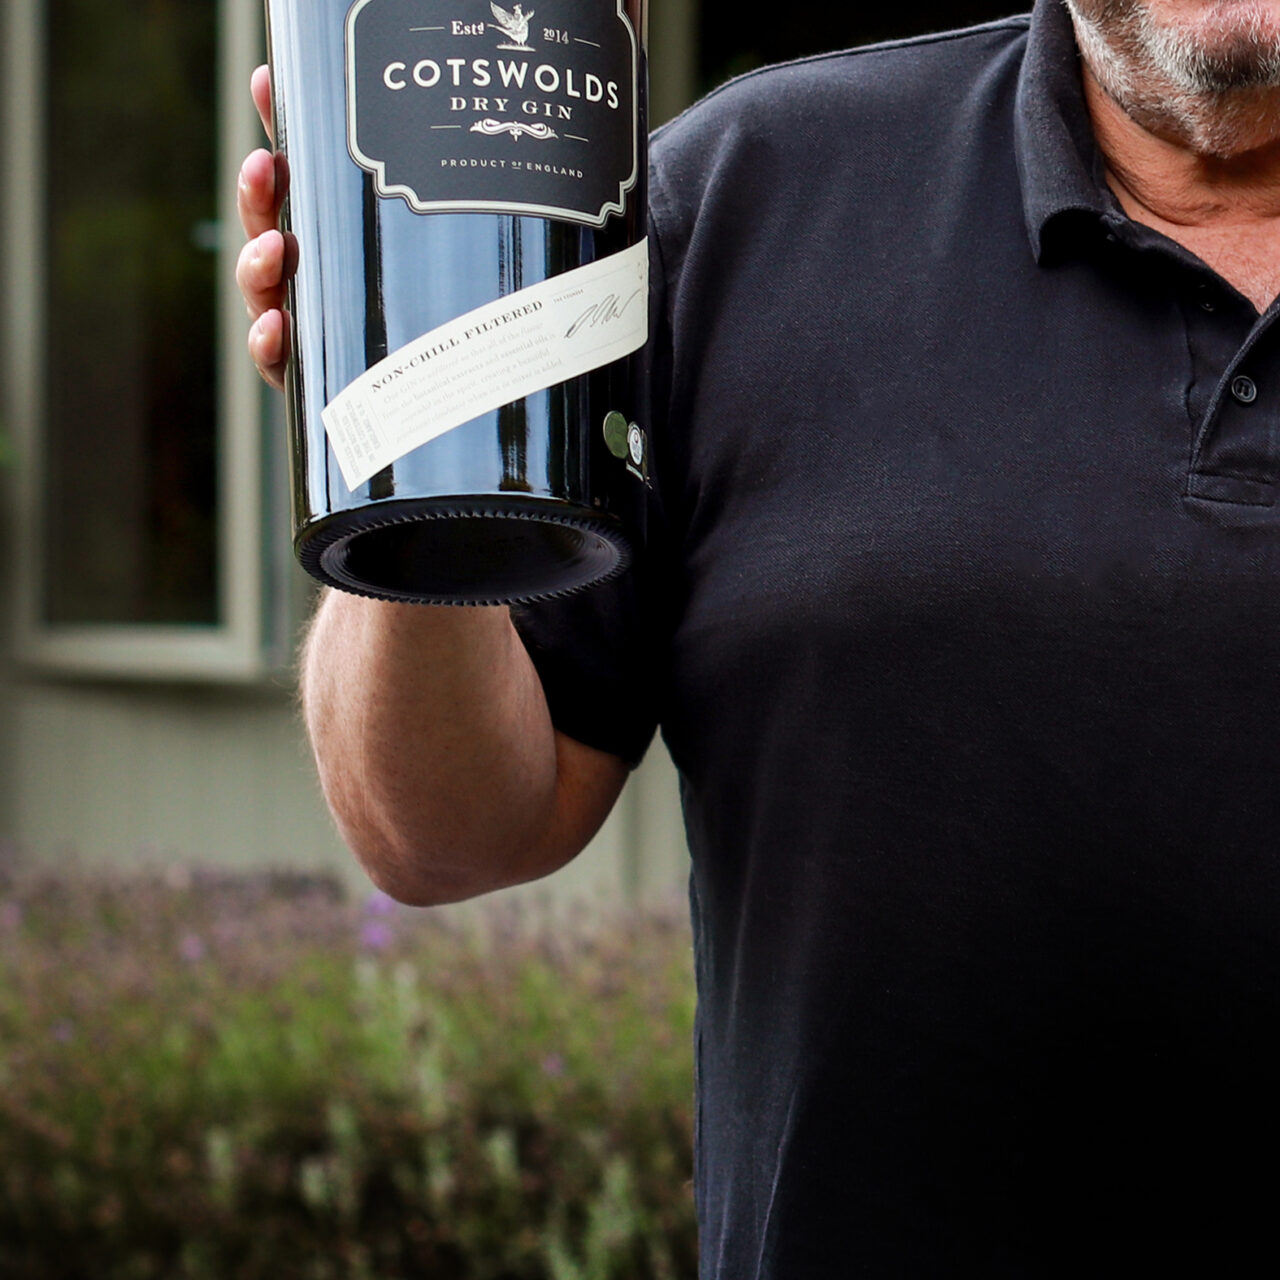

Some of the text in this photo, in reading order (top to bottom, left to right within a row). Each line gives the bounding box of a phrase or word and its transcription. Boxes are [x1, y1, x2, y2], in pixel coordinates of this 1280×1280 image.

[451, 20, 570, 44] Estd 2014
[383, 58, 619, 110] COTSWOLDS
[450, 96, 574, 121] DRY GIN
[441, 159, 506, 168] PRODUCT
[526, 162, 584, 180] ENGLAND
[371, 338, 460, 393] NON-CHILL
[464, 299, 544, 340] FILTERED
